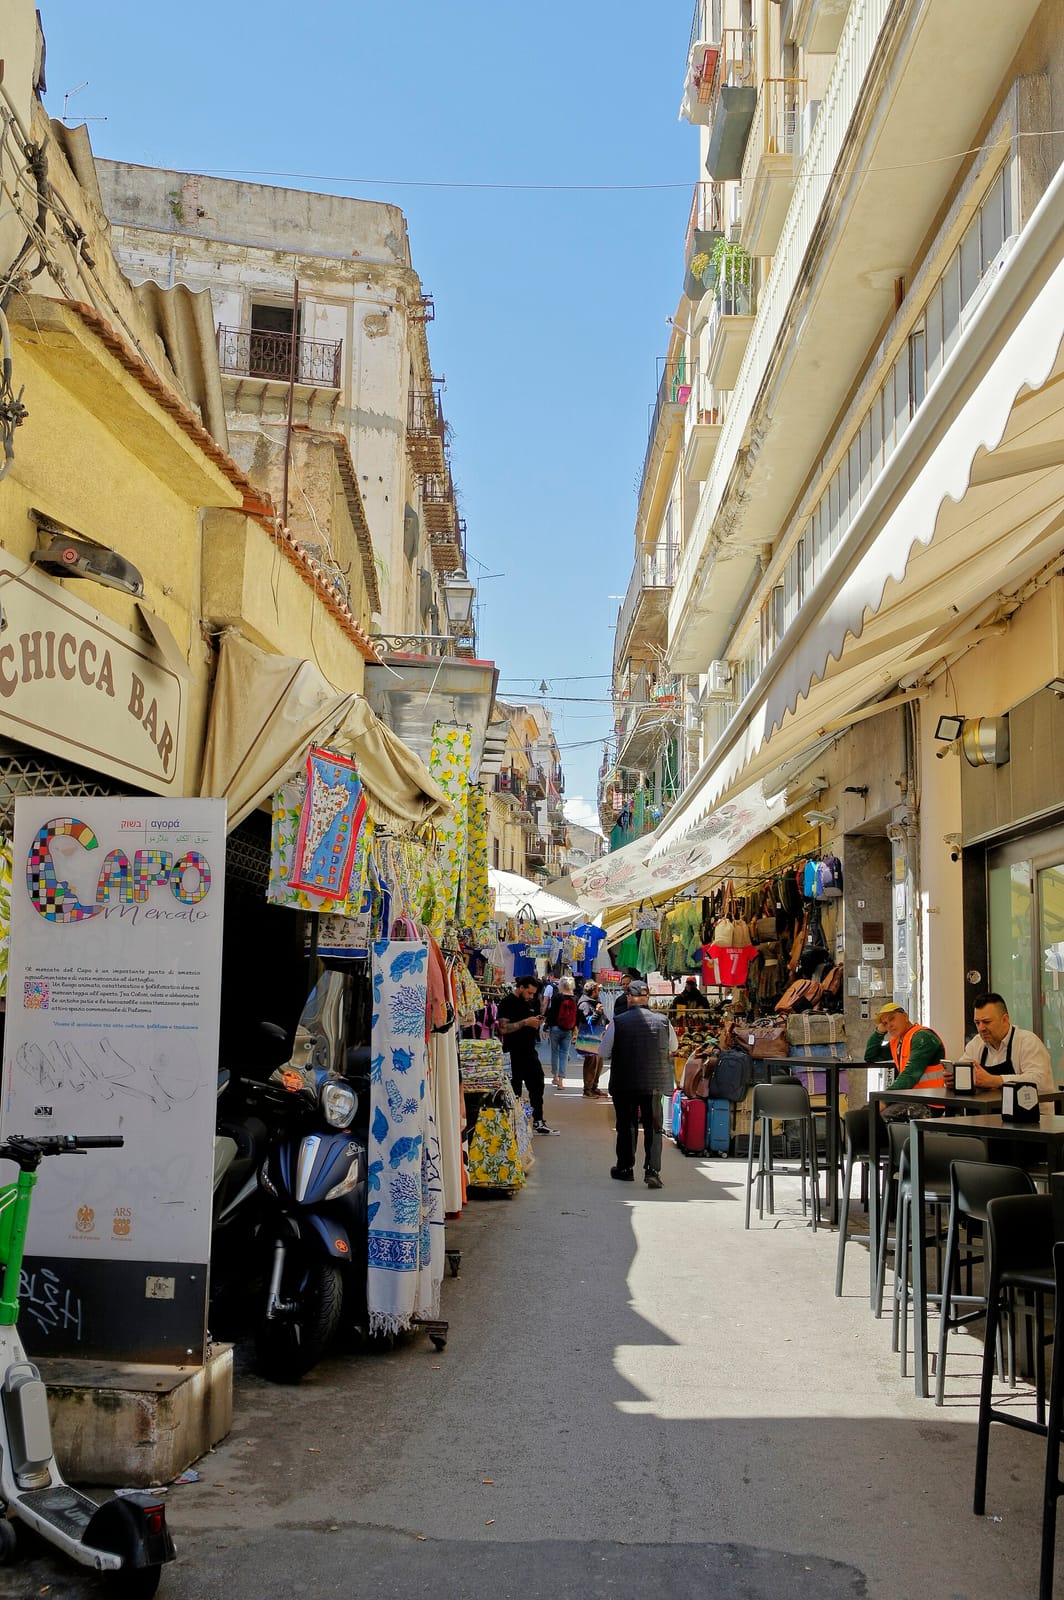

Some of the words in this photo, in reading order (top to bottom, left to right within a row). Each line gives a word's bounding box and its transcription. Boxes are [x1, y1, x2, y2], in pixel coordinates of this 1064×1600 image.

[127, 672, 173, 774] BAR
[150, 818, 180, 830] αγορά
[26, 816, 212, 923] CAPO
[104, 904, 209, 926] Mercato
[729, 953, 739, 975] 7
[113, 1207, 132, 1217] ARS
